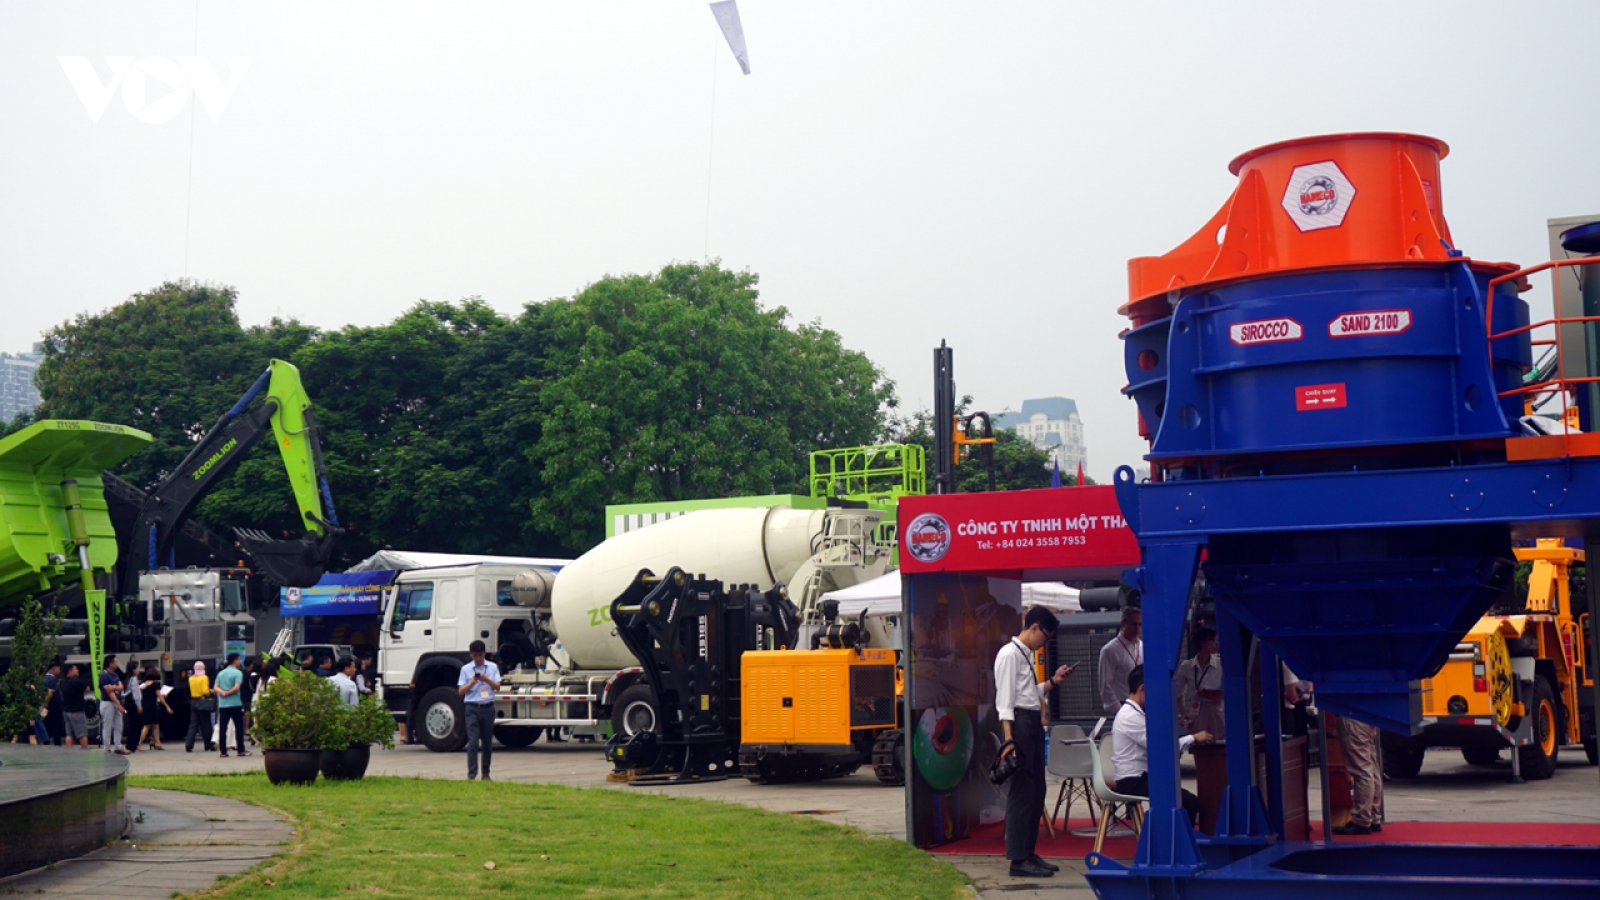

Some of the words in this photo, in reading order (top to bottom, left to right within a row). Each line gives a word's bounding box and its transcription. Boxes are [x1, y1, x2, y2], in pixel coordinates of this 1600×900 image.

[1240, 321, 1289, 341] SIROCCO
[1341, 316, 1370, 332] SAND
[1374, 314, 1398, 330] 2100
[192, 438, 237, 480] ZOOMLION
[957, 519, 997, 536] CÔNG
[1000, 520, 1018, 534] TY
[1021, 518, 1062, 533] TNHH
[1065, 513, 1098, 533] MỘT
[976, 540, 993, 550] Tel:
[996, 539, 1014, 548] +84
[1015, 538, 1033, 547] 024
[1036, 537, 1060, 546] 3558
[1061, 535, 1086, 545] 7953
